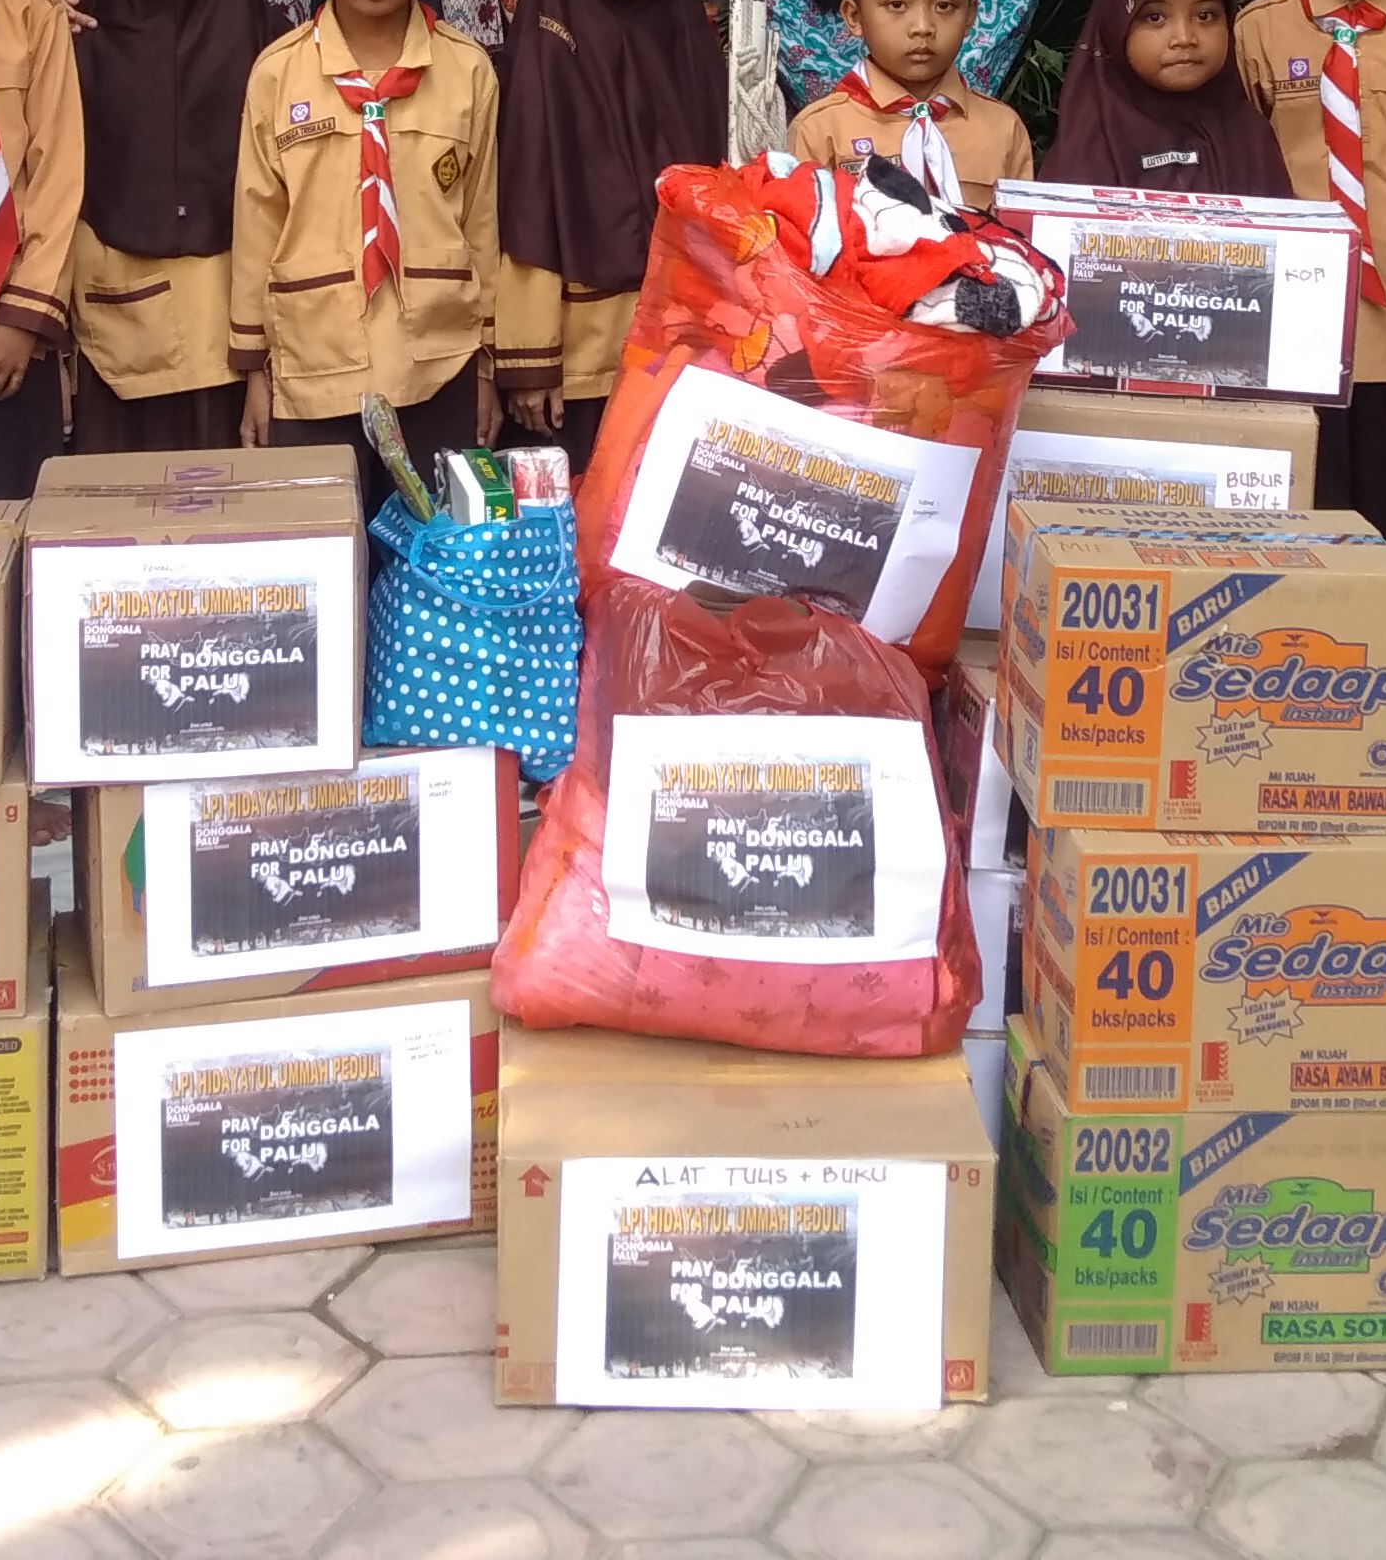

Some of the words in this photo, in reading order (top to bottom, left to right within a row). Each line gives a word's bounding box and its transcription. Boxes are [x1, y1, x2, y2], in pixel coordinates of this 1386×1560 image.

[1080, 232, 1101, 256] LPI
[1102, 234, 1171, 261] HIDAYATUL
[1173, 238, 1220, 265] UMMAH
[1223, 241, 1265, 267] PEDULI
[1119, 299, 1145, 313] FOR
[1152, 312, 1203, 328] PALU
[1120, 281, 1154, 296] PRAY
[1154, 292, 1260, 312] DONGGALA
[704, 419, 732, 449] LPI
[727, 426, 805, 475] HIDAYATUL
[801, 452, 855, 493] UMMAH
[852, 470, 902, 509] PEDULI
[729, 500, 760, 522] FOR
[760, 523, 816, 554] PALU
[736, 481, 775, 506] PRAY
[768, 503, 881, 554] DONGGALA
[90, 591, 113, 619] LPI
[116, 588, 195, 618] HIDAYATUL
[199, 585, 252, 615] UMMAH
[257, 583, 305, 613] PEDULI
[1062, 579, 1158, 631] 20031
[1175, 588, 1234, 638] BARU
[141, 642, 180, 658] PRAY
[180, 647, 304, 667] DONGGALA
[141, 664, 171, 679] FOR
[180, 673, 239, 690] PALU
[1067, 665, 1144, 717] 40
[1060, 722, 1145, 745] bks/packs
[1261, 789, 1298, 810] RASA
[1303, 789, 1342, 811] AYAM
[1091, 864, 1186, 916] 20031
[1234, 913, 1291, 936] Mie
[1097, 949, 1174, 1001] 40
[1075, 1127, 1170, 1173] 20032
[636, 1165, 706, 1188] ALAT
[725, 1167, 788, 1188] TULIS
[821, 1165, 889, 1184] BUKU
[1080, 1208, 1158, 1259] 40
[1268, 1317, 1335, 1339] RASA
